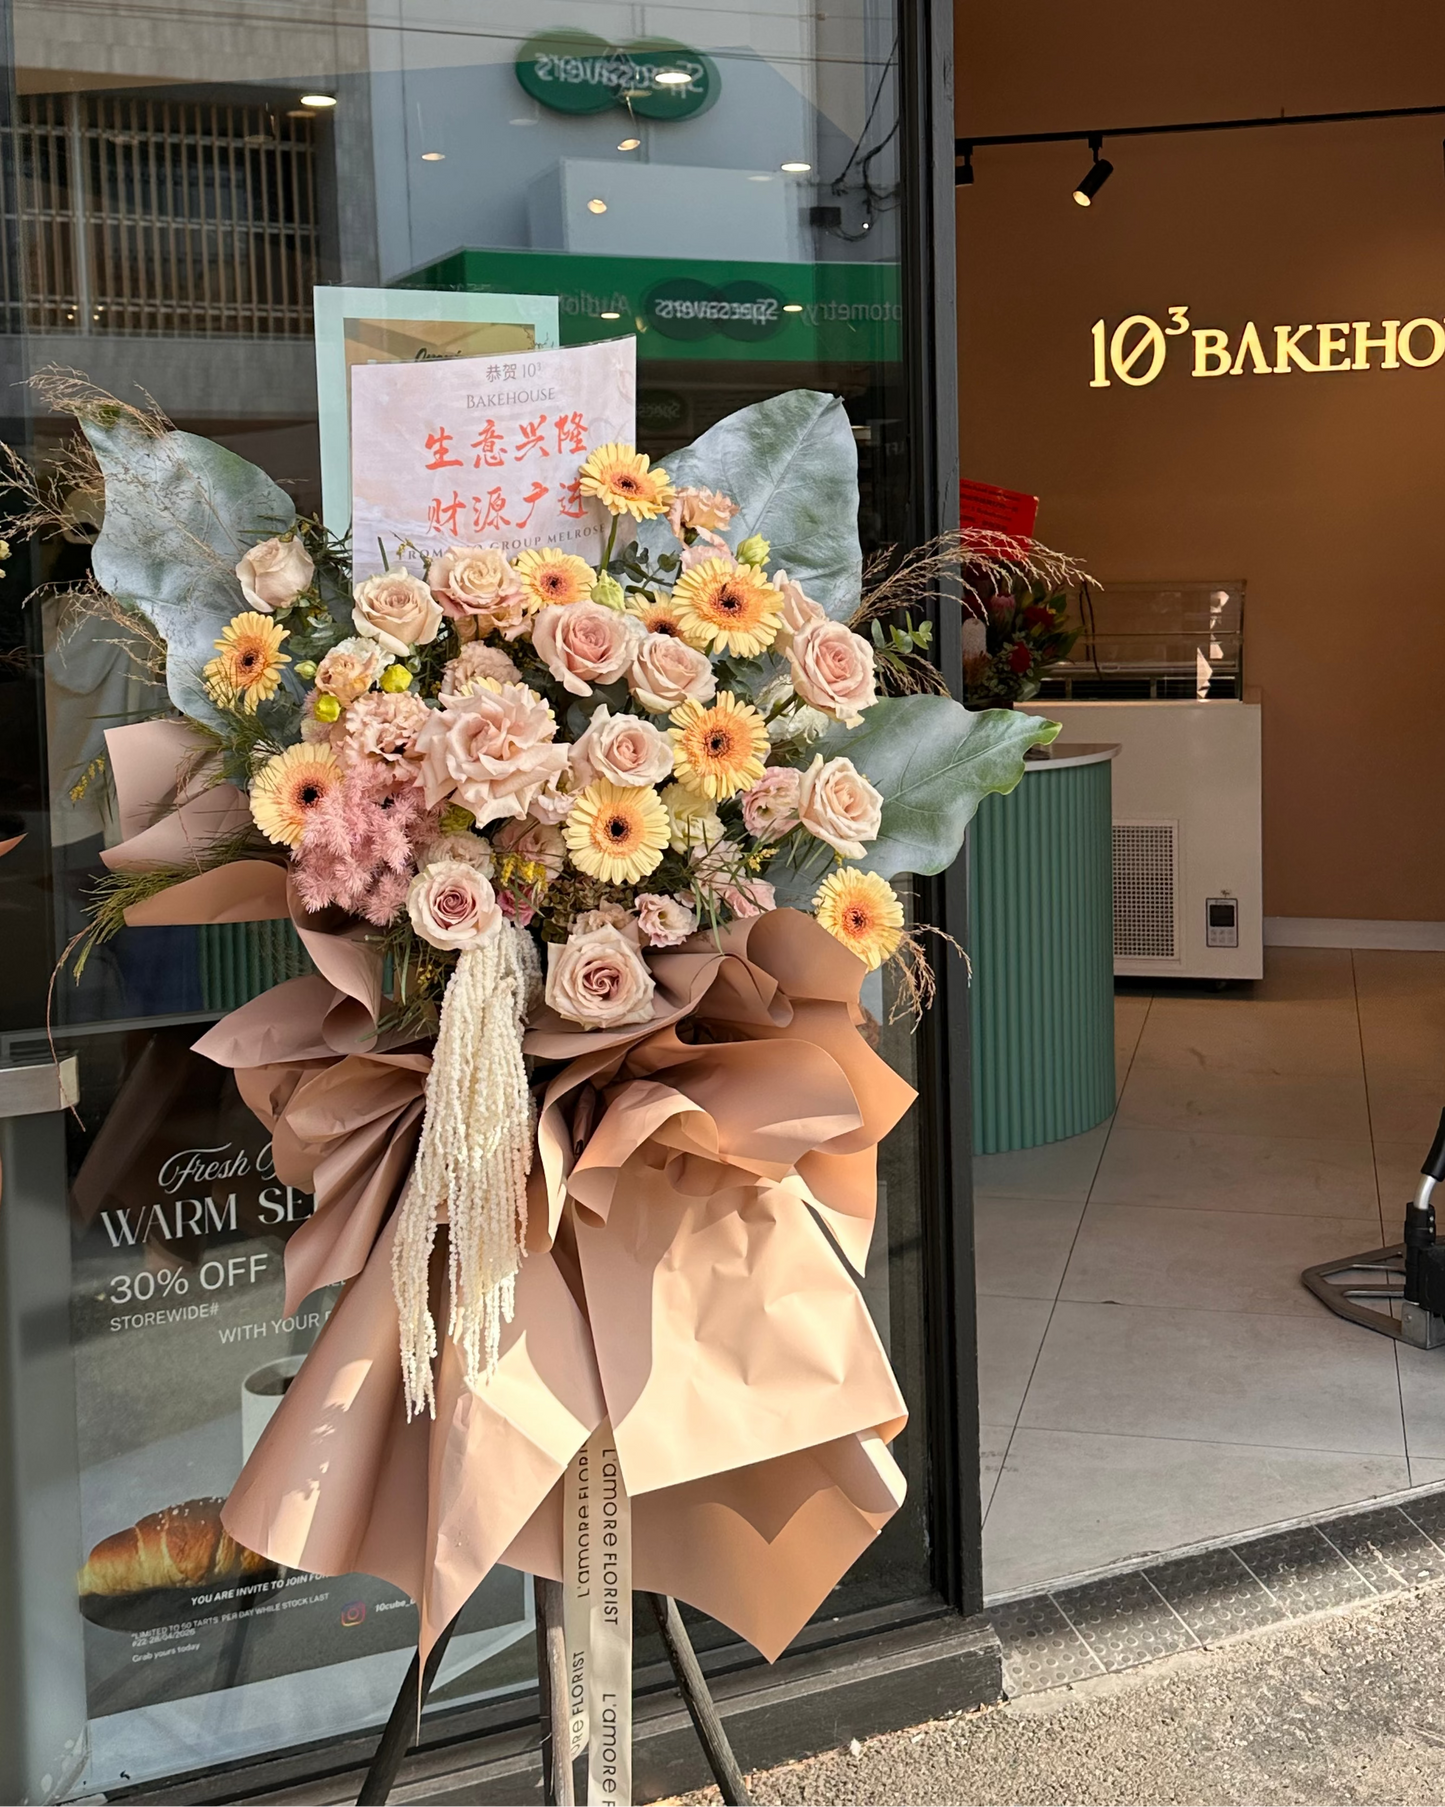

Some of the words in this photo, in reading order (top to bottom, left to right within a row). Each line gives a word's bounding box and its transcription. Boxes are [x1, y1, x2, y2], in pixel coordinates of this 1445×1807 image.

[1191, 316, 1445, 378] BAKEHO
[486, 363, 517, 383] 恭贺
[466, 387, 556, 410] BAKEHOUSE
[425, 411, 589, 471] 生意兴隆
[426, 477, 589, 537] 财源广进
[547, 522, 606, 544] MELROSE
[158, 1142, 250, 1194] Fresh
[101, 1193, 238, 1248] WARM
[110, 1265, 190, 1305] 30%
[200, 1253, 269, 1291] OFF
[110, 1302, 220, 1332] STOREWIDE#
[219, 1322, 267, 1344] WITH
[271, 1312, 320, 1336] YOUR
[191, 1591, 214, 1607] YOU
[214, 1588, 235, 1602] ARE
[236, 1582, 270, 1597] INVITE
[271, 1579, 285, 1590] TO
[286, 1573, 308, 1587] JOIN
[193, 1616, 219, 1627] TARTS
[221, 1612, 238, 1623] PER
[239, 1608, 254, 1619] DAY
[255, 1602, 281, 1615] WHILE
[281, 1597, 308, 1610] STOCK
[309, 1592, 330, 1605] LAST
[603, 1552, 619, 1626] FLORIST
[132, 1652, 153, 1663] Grab
[177, 1643, 201, 1654] today
[571, 1650, 585, 1717] FLORIST
